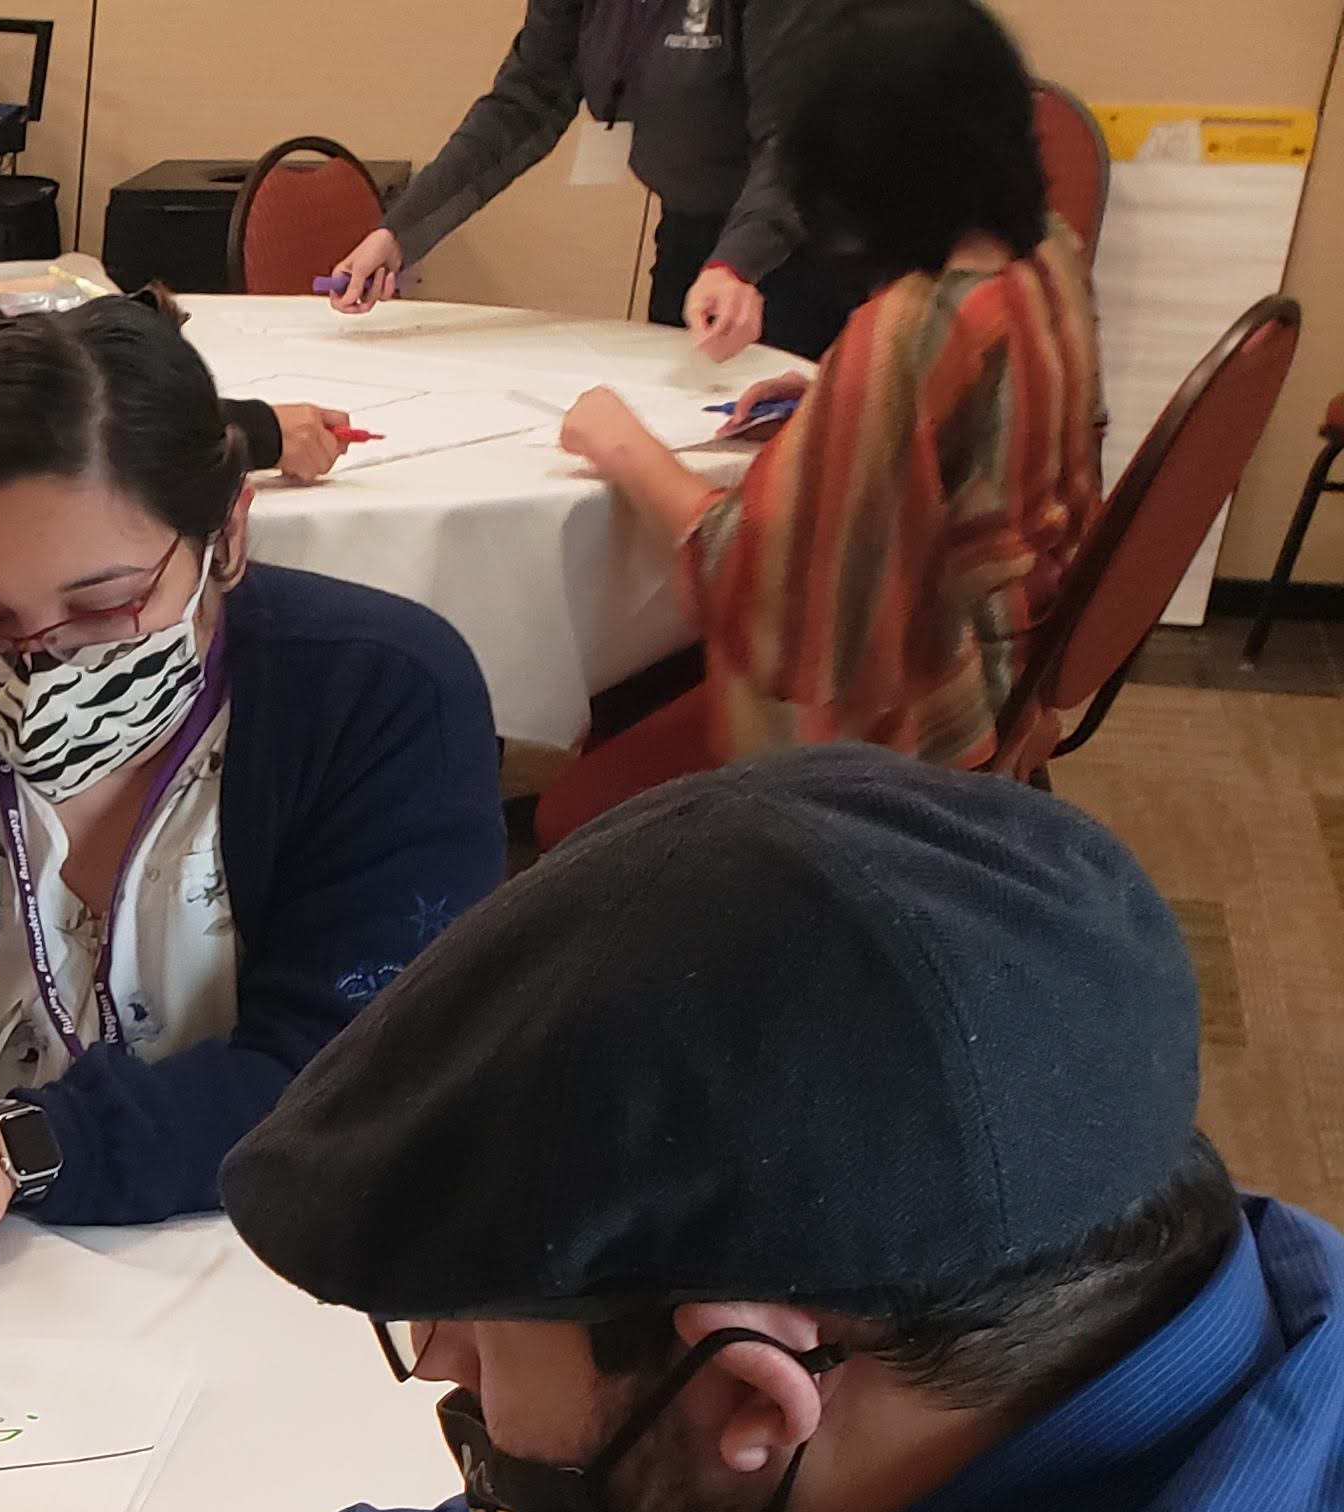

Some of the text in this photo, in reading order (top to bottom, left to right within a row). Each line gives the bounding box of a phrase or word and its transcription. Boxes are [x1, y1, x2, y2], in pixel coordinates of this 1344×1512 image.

[8, 808, 30, 882] Educating
[26, 895, 49, 973] Supporting
[47, 986, 75, 1036] Serving
[98, 994, 118, 1045] Region
